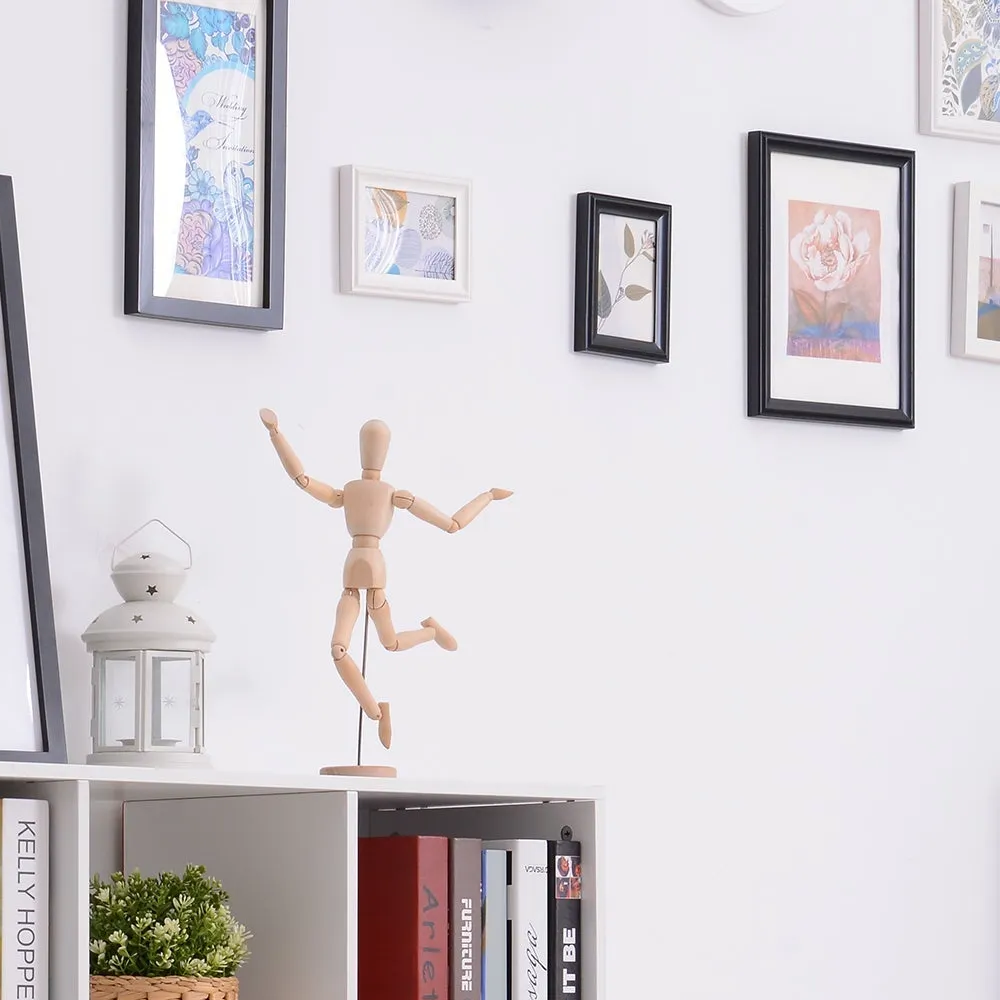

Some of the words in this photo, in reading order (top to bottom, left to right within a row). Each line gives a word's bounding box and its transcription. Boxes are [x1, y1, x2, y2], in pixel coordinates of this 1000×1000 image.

[17, 820, 36, 900] KELLY
[562, 927, 577, 963] BE
[562, 968, 577, 993] IT
